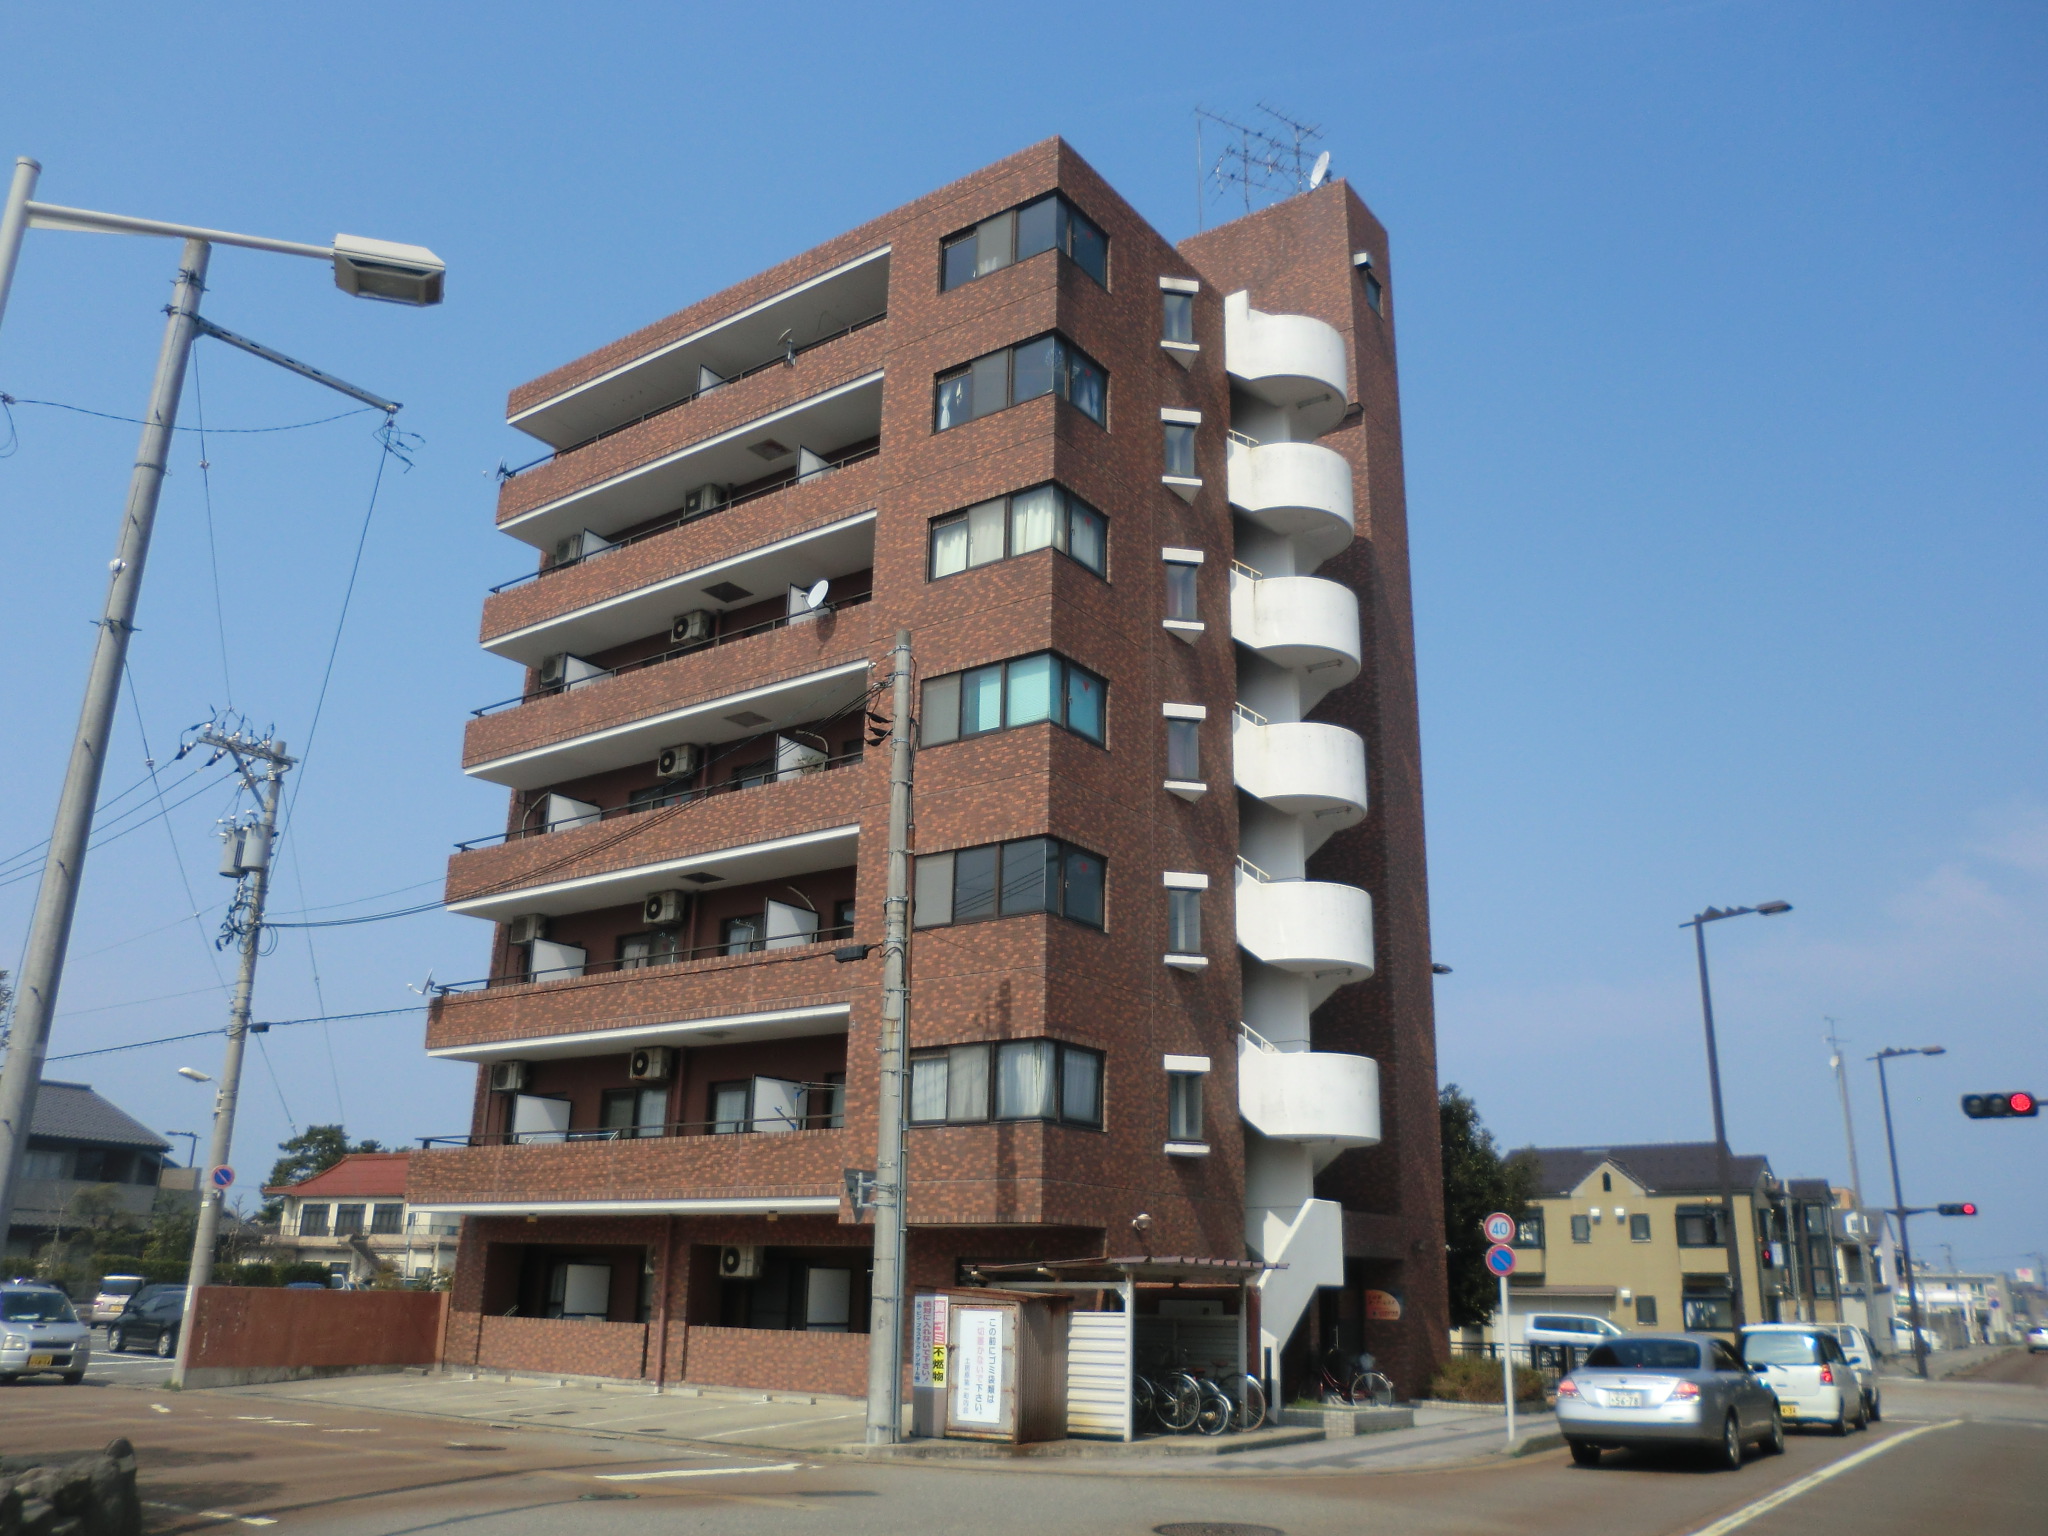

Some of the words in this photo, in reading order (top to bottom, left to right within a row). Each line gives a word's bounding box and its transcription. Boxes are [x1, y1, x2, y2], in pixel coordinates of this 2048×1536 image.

[1492, 1222, 1508, 1235] 40
[932, 1346, 944, 1381] 不燃物
